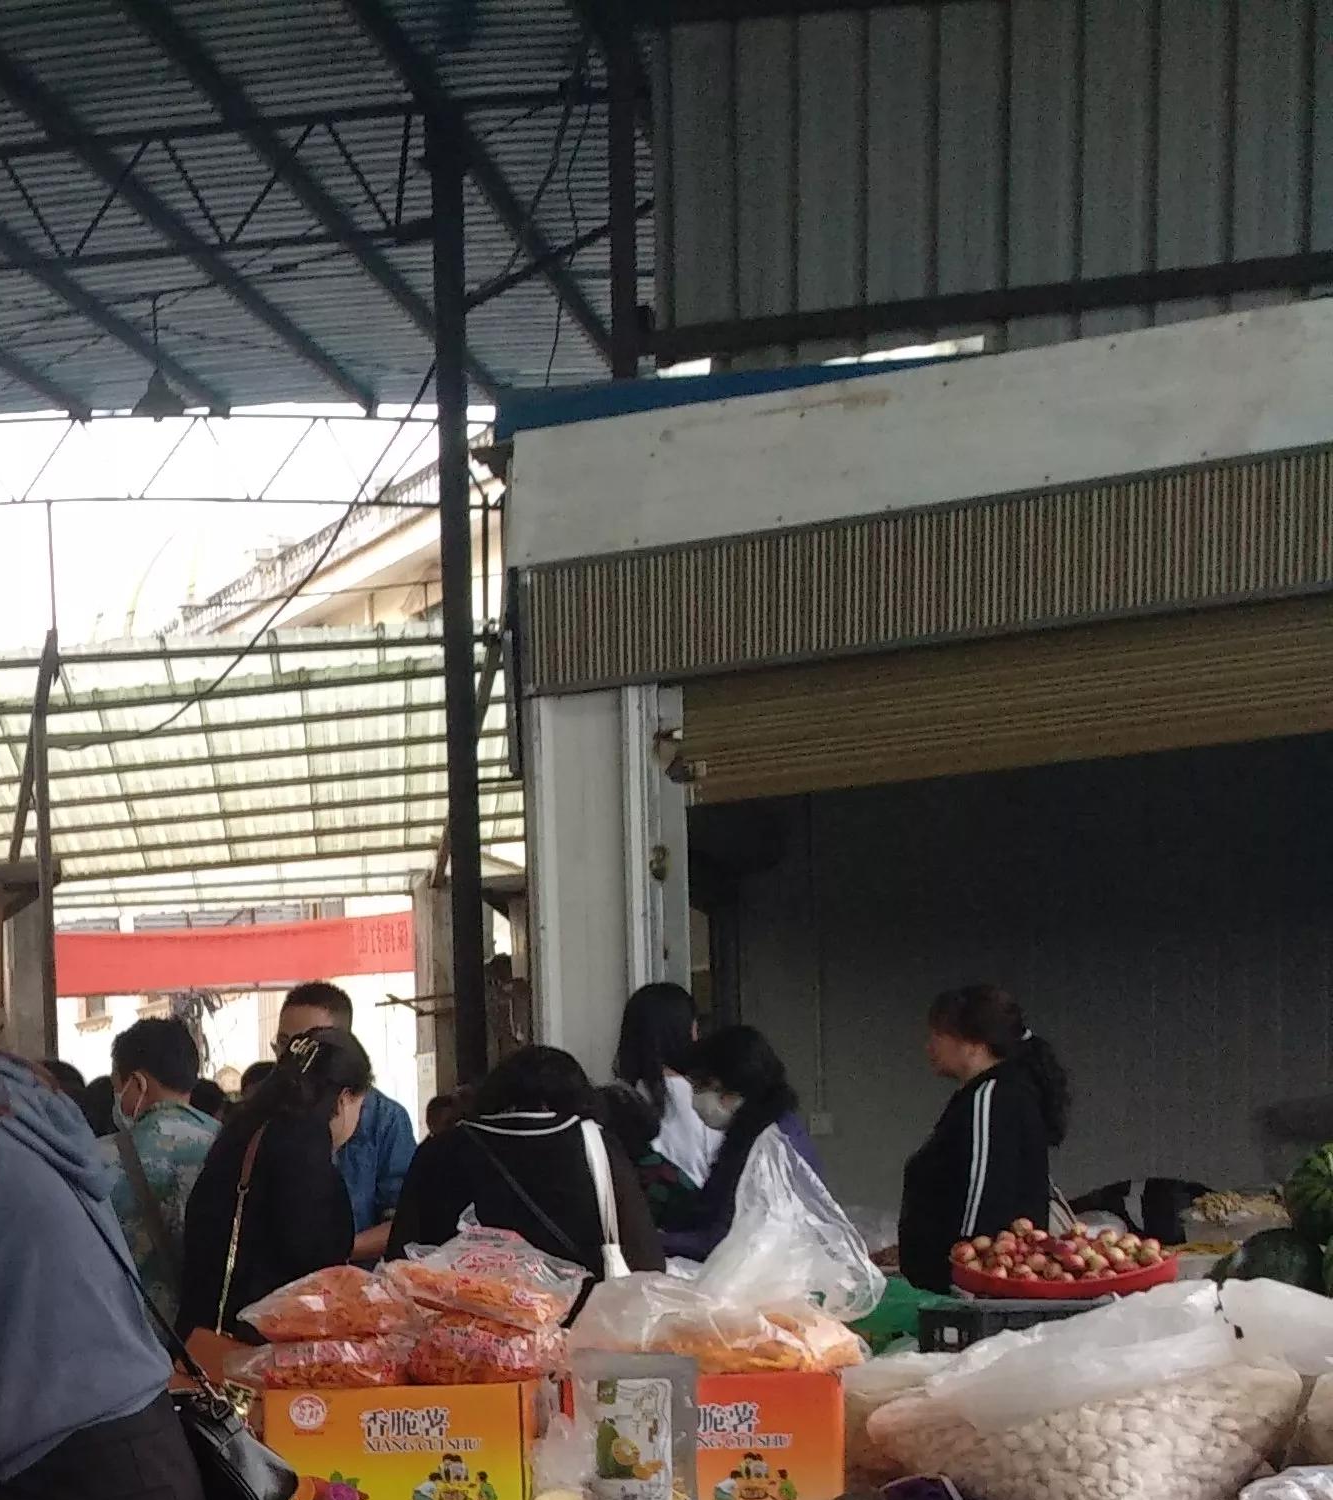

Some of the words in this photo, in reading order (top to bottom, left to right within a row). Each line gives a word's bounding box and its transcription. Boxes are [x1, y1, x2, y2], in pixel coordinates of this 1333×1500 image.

[362, 1407, 450, 1437] 香脆薯
[698, 1403, 758, 1434] 脆薯
